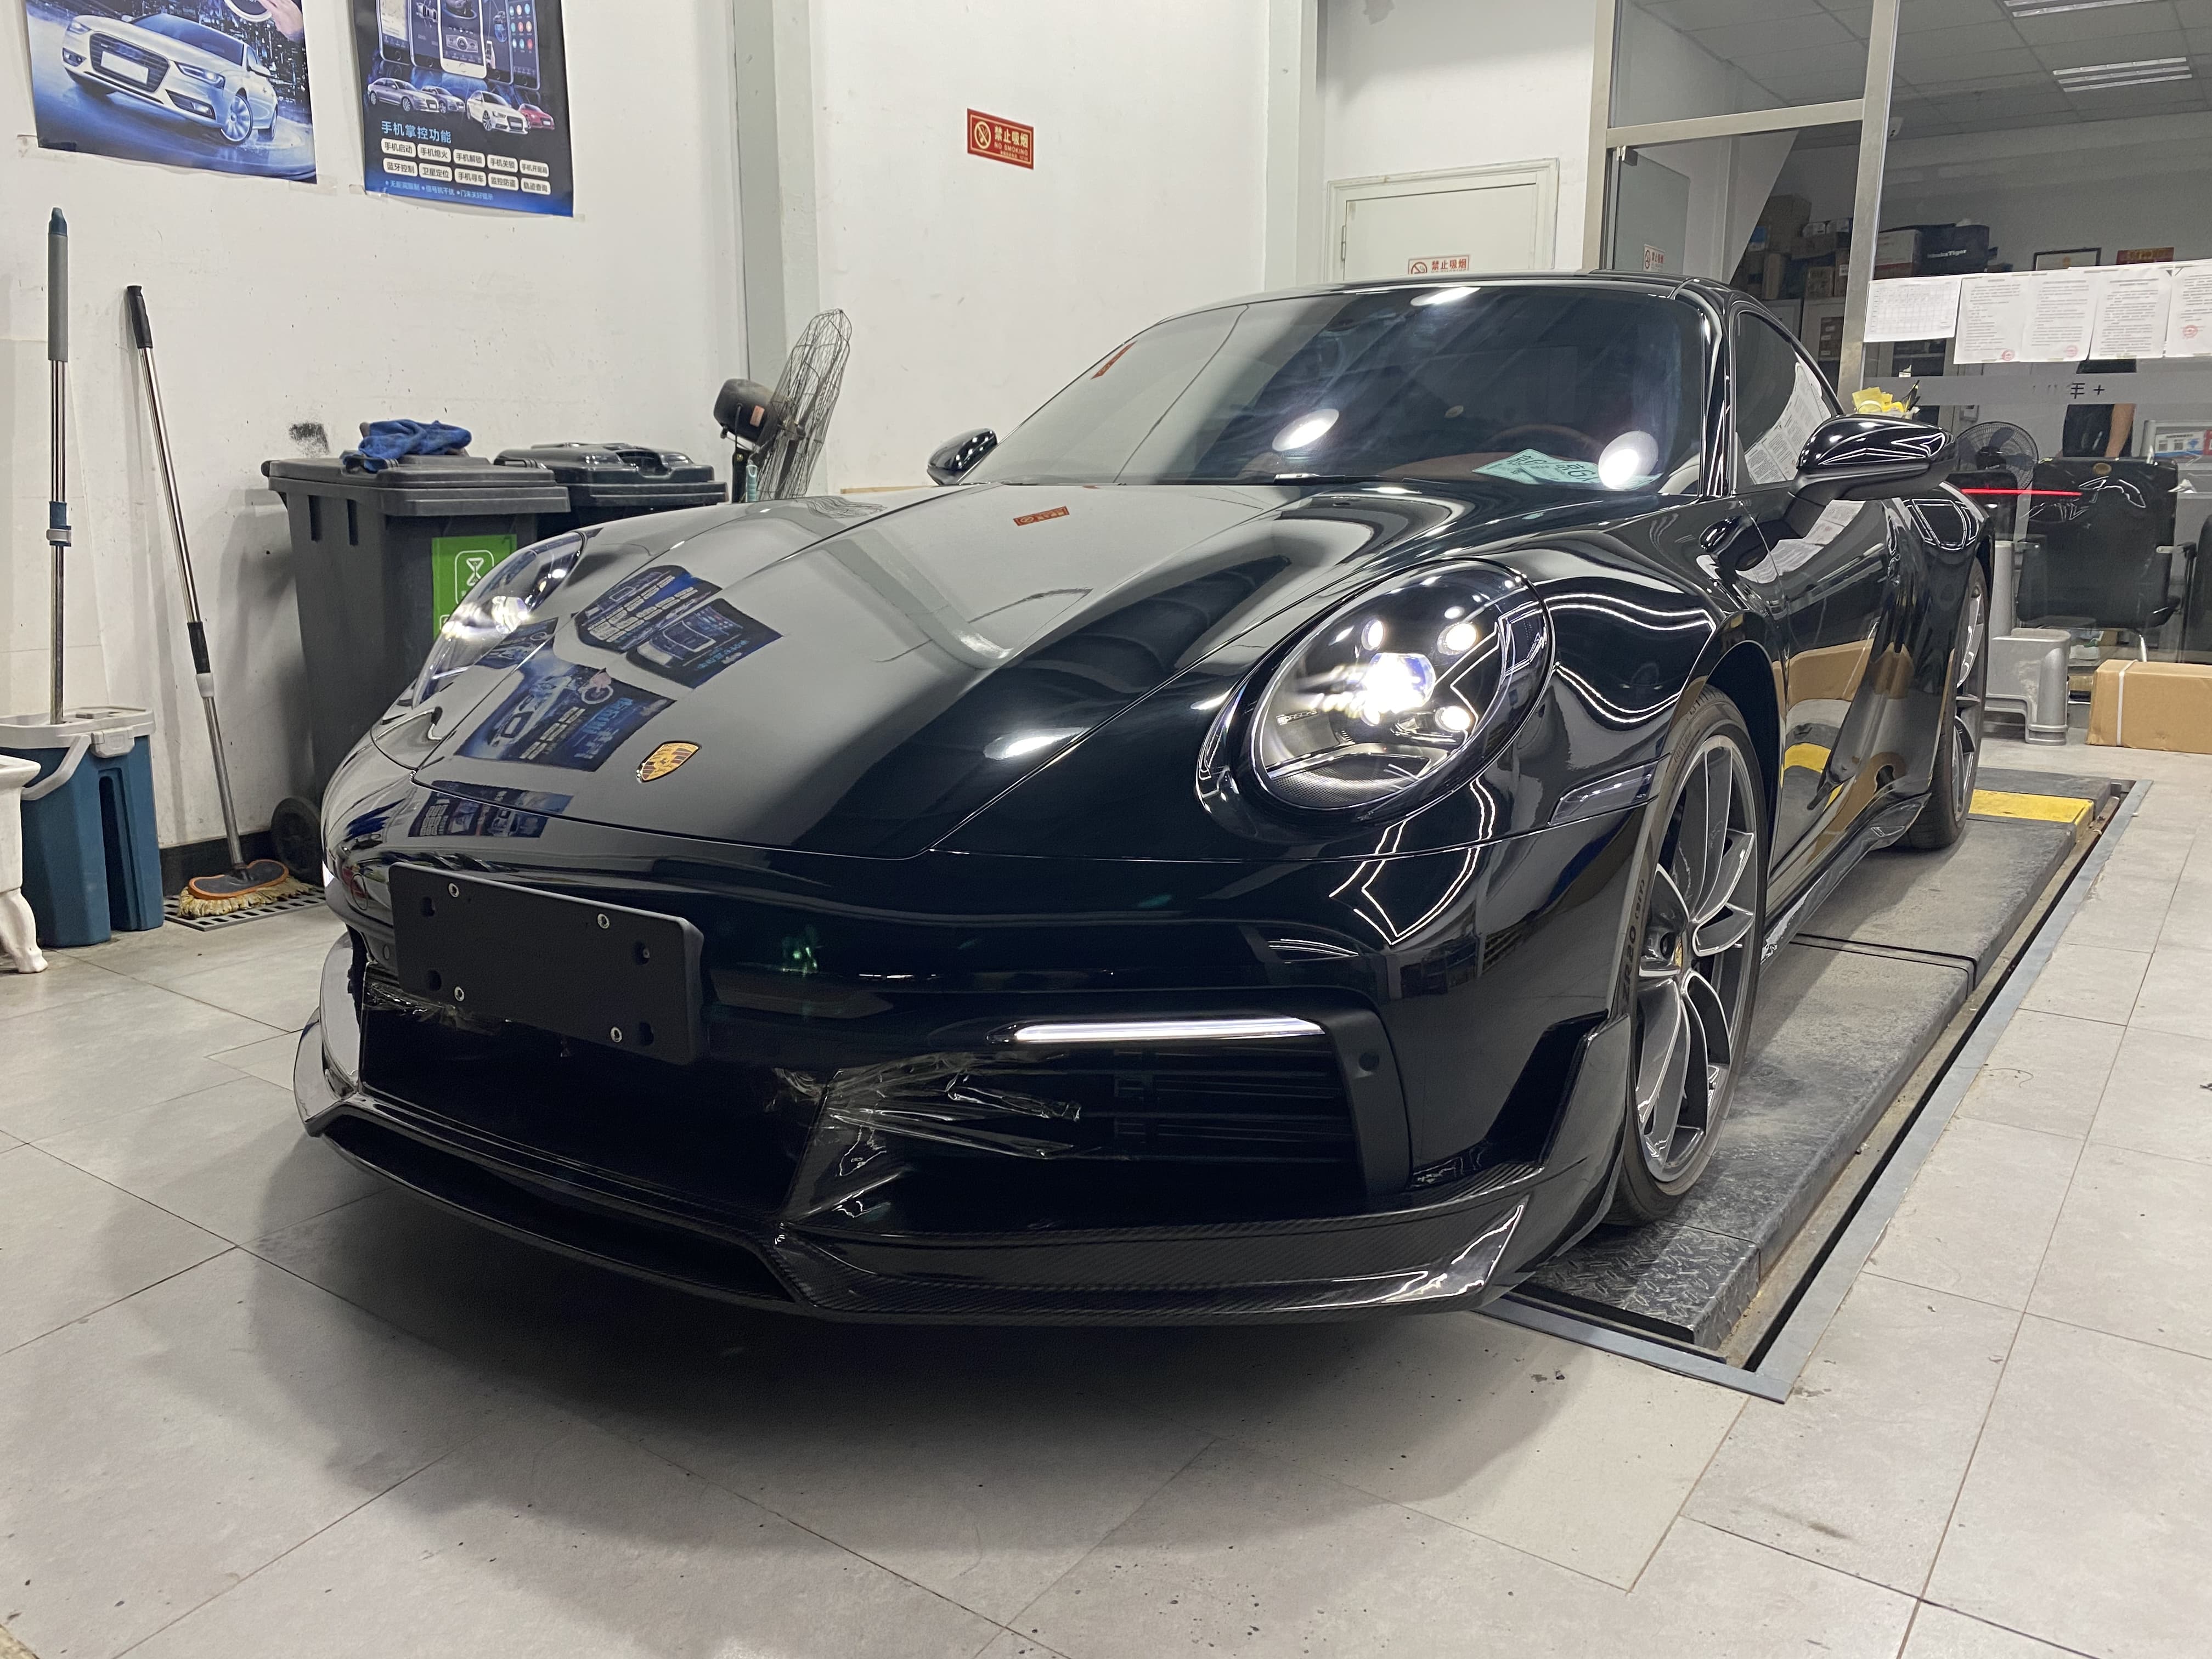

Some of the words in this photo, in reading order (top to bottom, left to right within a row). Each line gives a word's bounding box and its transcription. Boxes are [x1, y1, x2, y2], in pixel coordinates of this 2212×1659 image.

[381, 120, 452, 143] 手机掌控功能
[994, 126, 1028, 148] 禁止吸烟
[384, 142, 413, 154] 手机启动
[420, 147, 448, 159] 手机熄火
[456, 152, 482, 164] 手机解锁
[490, 157, 515, 170] 手机关锁
[994, 142, 1002, 150] NO
[1004, 145, 1028, 156] SMOKING
[386, 161, 415, 174] 蓝牙控制
[422, 167, 449, 179] 卫星定位
[458, 171, 484, 183] 手机寻车
[491, 177, 516, 188] 监控防盗
[1431, 258, 1467, 270] 禁止吸烟
